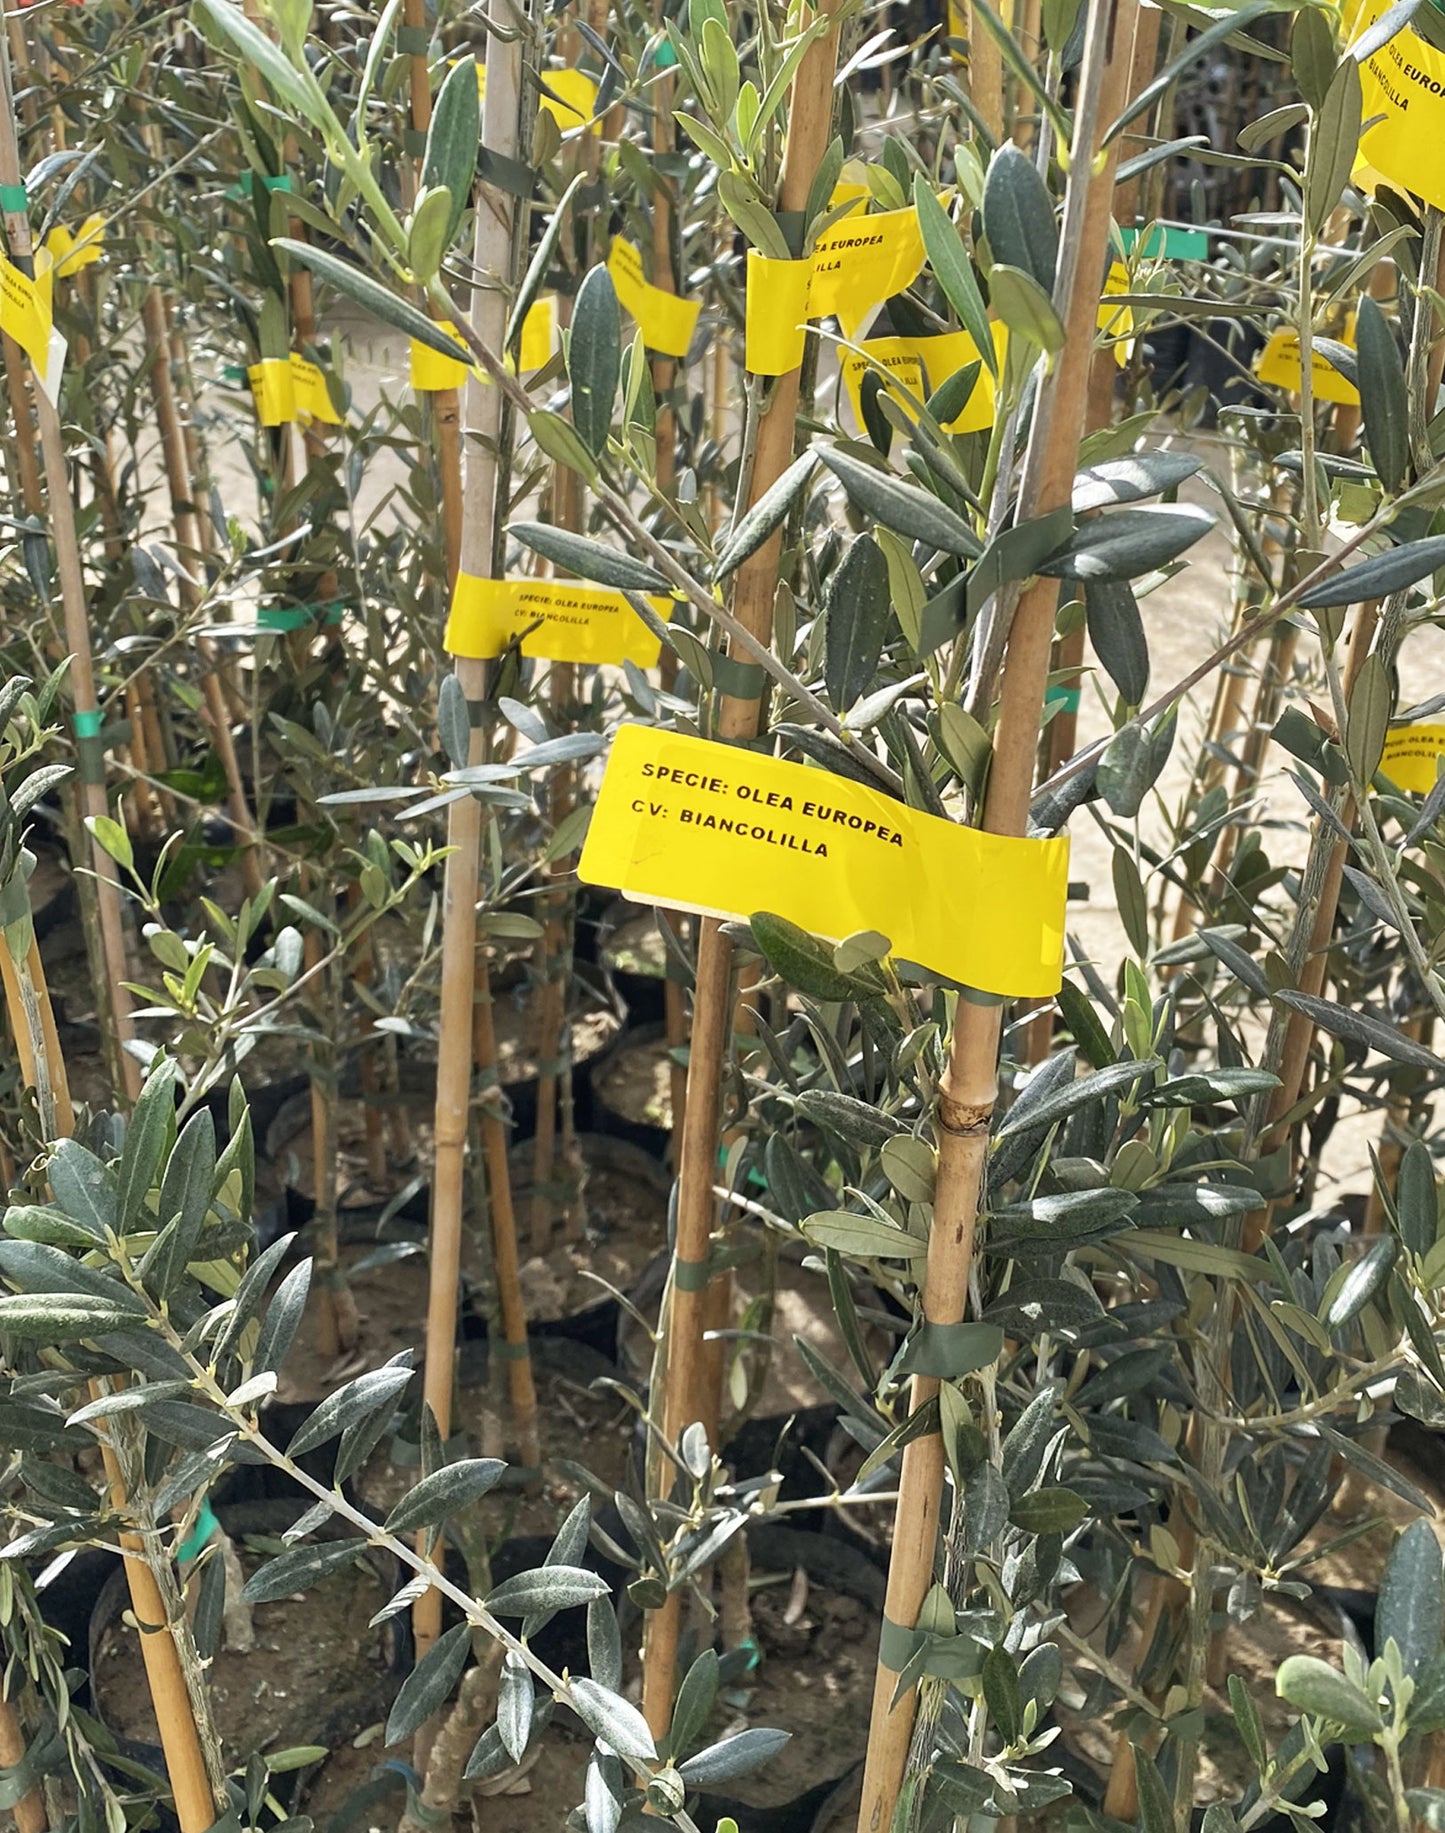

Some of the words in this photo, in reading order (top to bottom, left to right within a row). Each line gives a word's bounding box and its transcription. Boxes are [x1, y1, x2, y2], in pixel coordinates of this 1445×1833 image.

[1368, 58, 1409, 111] BIANCOLILLA
[830, 234, 884, 250] EUROPEA
[519, 593, 552, 605] SPECIE:
[555, 598, 579, 609] OLEA
[581, 602, 620, 613] EUROPEA
[631, 799, 668, 818] CV:
[680, 809, 829, 857] BIANCOLILLA
[641, 763, 729, 794] SPECIE:
[736, 785, 793, 811] OLEA
[802, 802, 904, 847] EUROPEA
